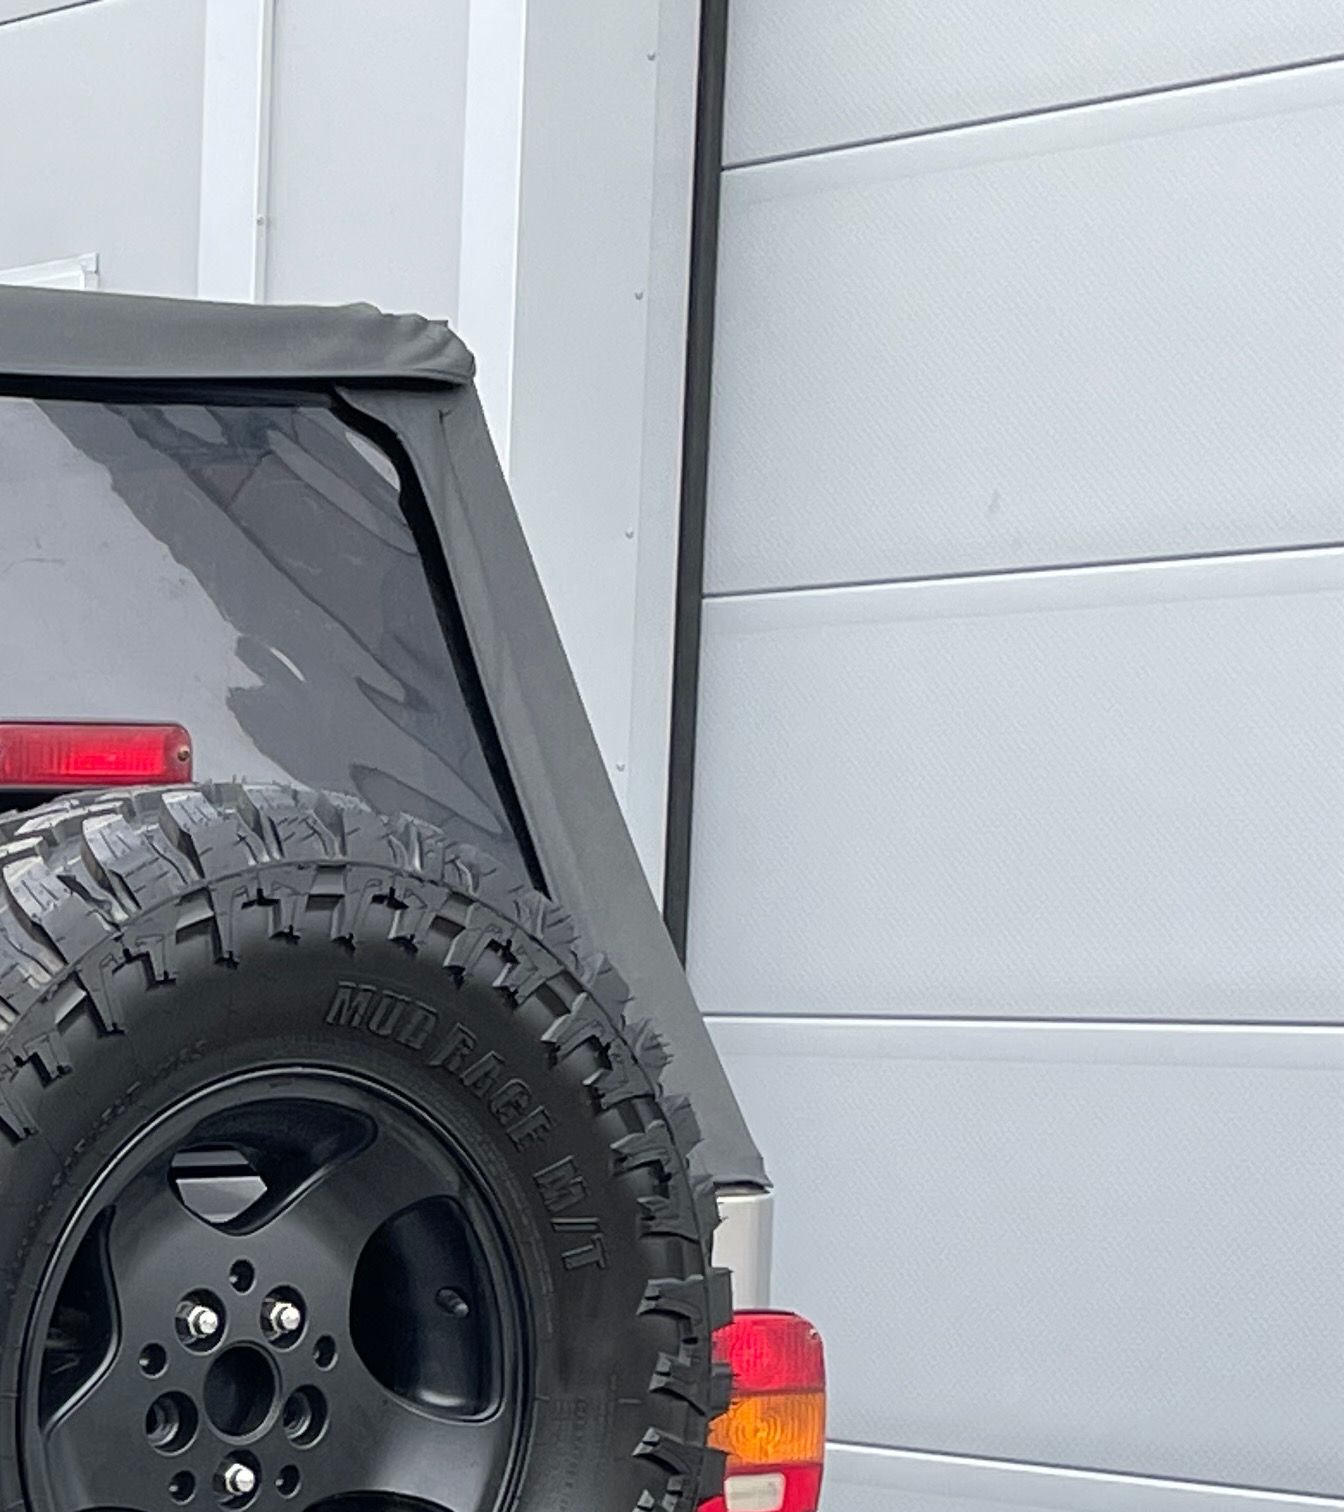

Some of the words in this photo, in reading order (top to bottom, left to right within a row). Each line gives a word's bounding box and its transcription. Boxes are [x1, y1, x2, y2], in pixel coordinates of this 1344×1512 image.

[324, 980, 440, 1050] MUD
[428, 1022, 556, 1152] RAGE
[532, 1154, 607, 1271] M/T
